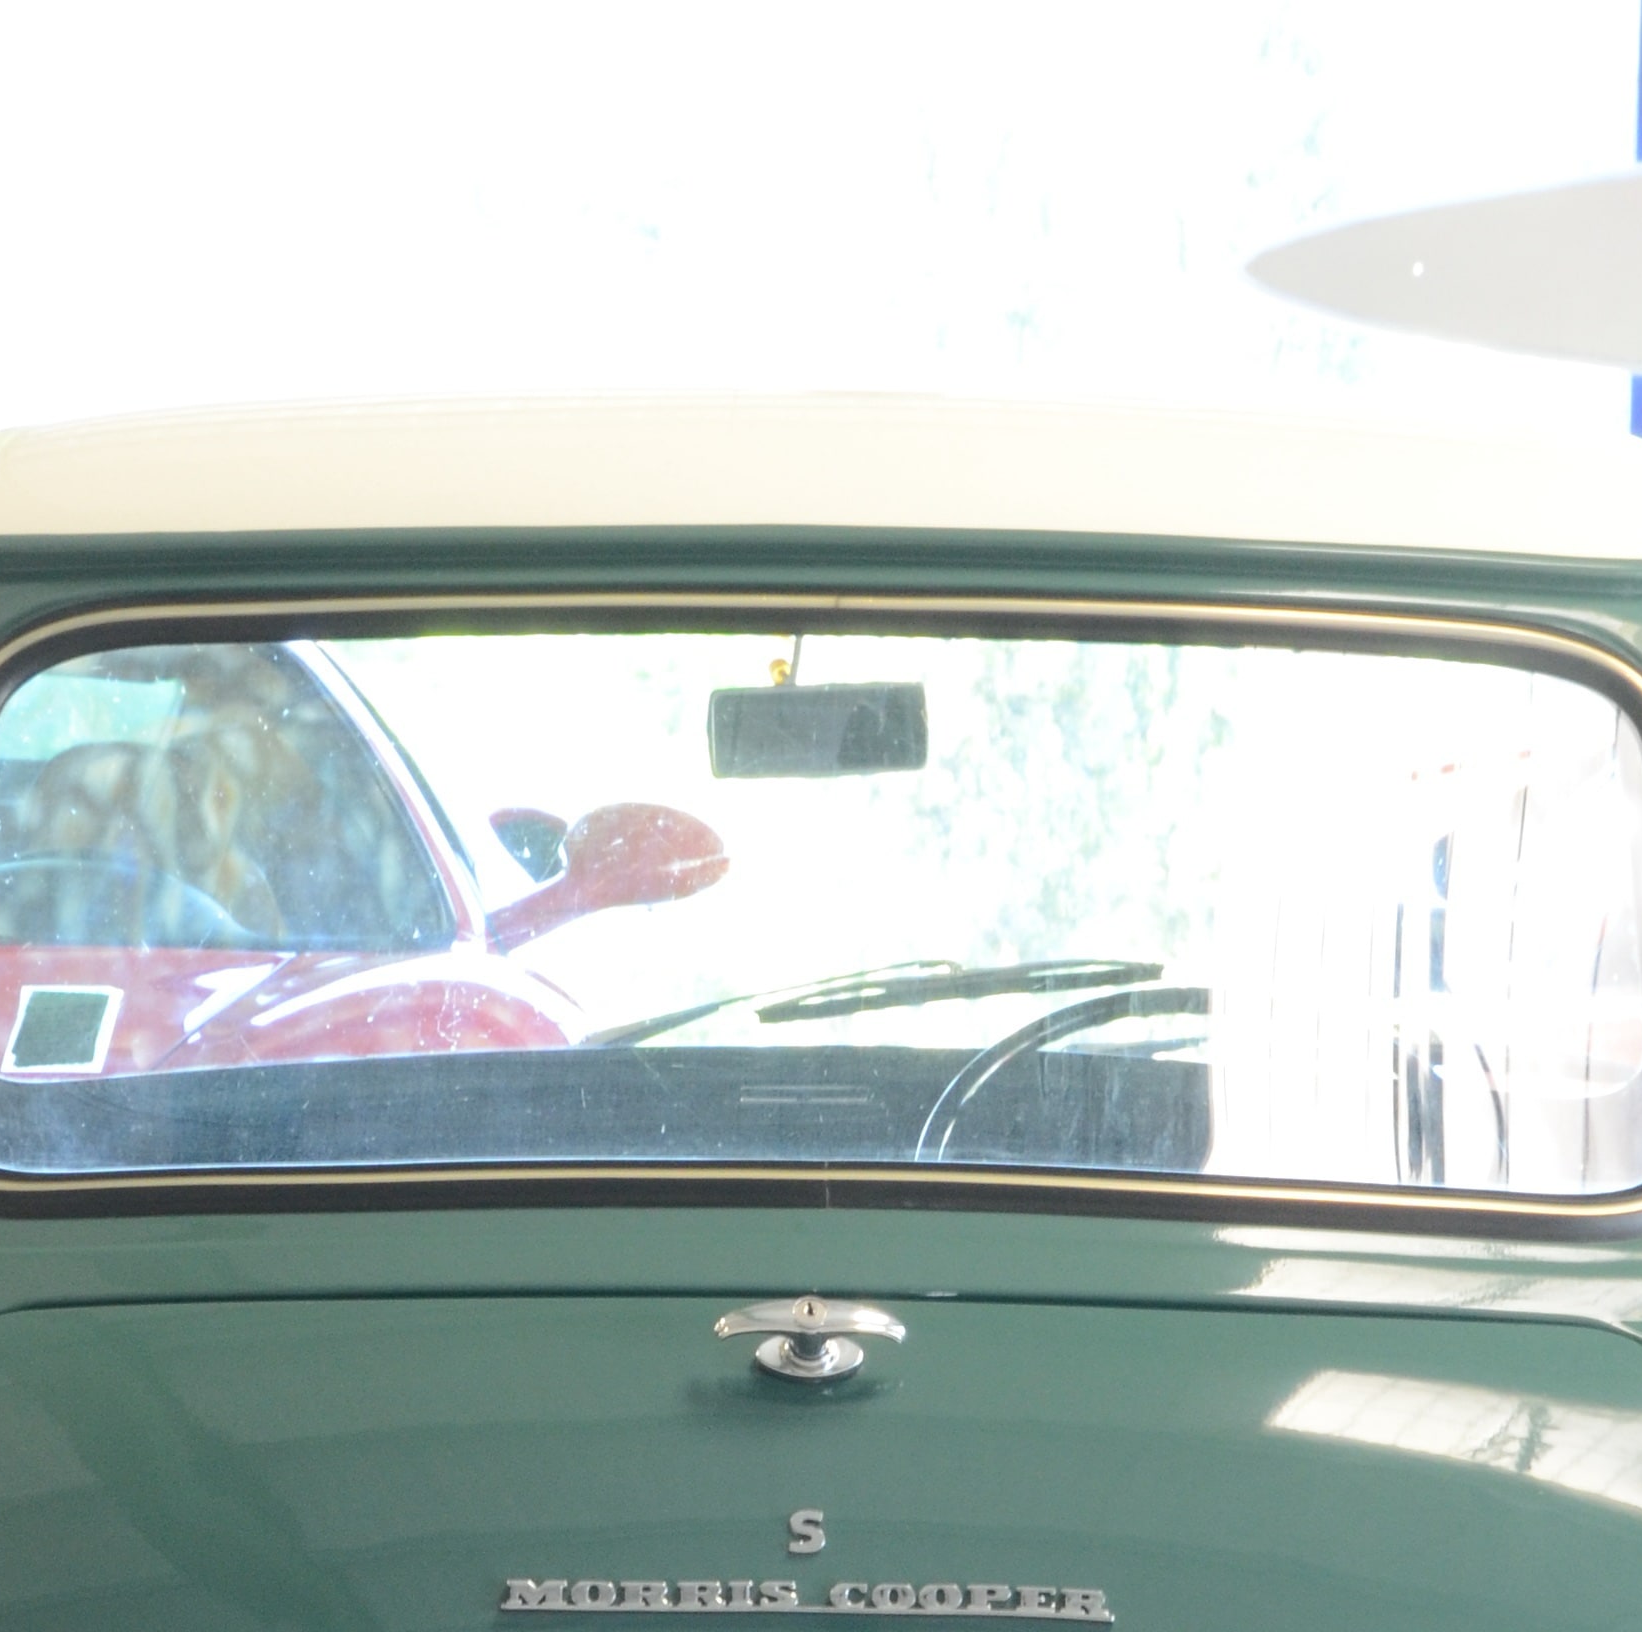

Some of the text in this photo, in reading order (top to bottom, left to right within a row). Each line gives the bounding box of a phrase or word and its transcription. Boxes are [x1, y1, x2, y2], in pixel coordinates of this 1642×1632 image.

[788, 1509, 826, 1554] S
[503, 1579, 1112, 1618] MORRIS COOPER
